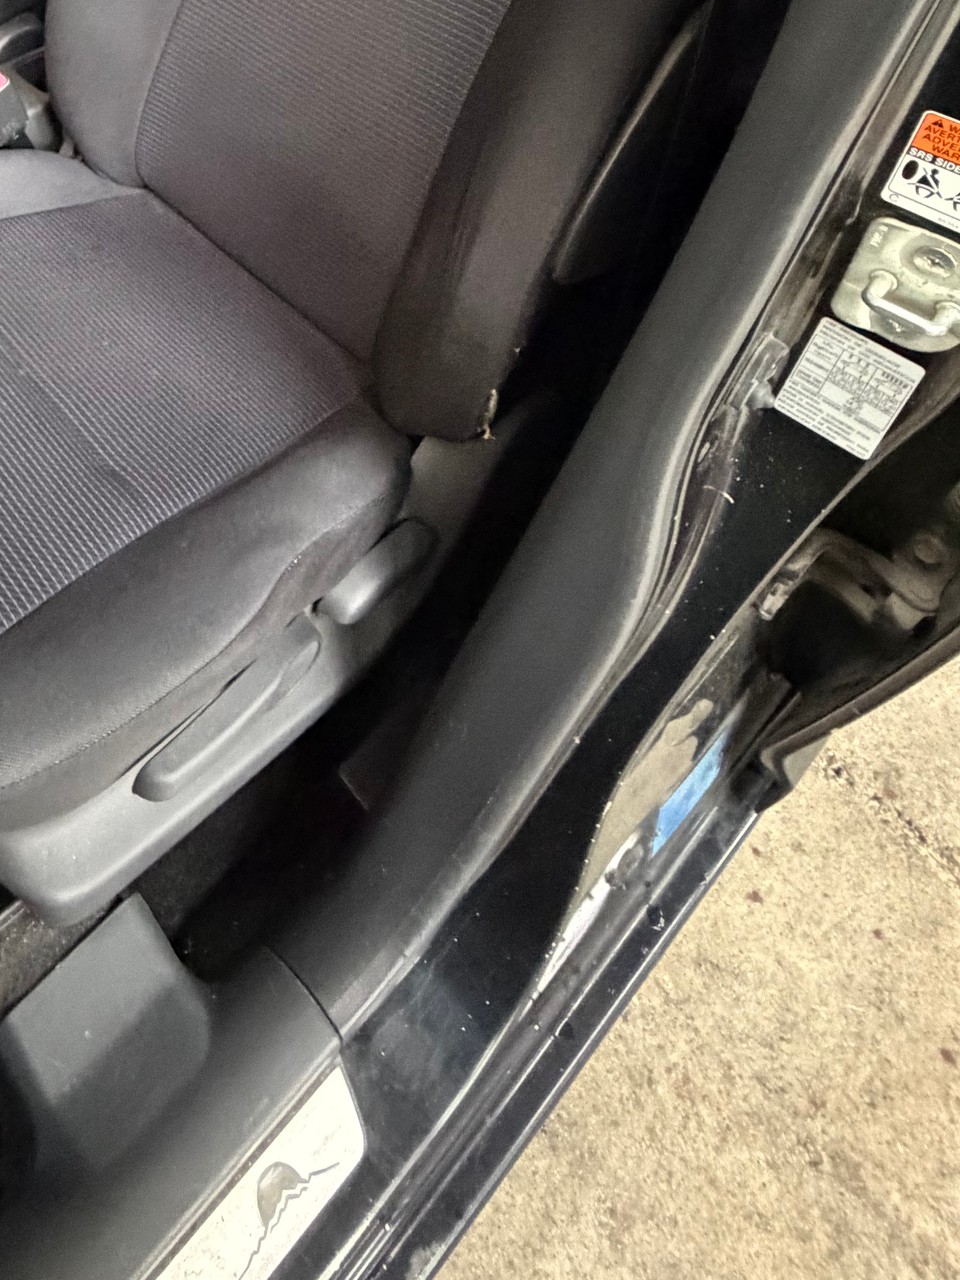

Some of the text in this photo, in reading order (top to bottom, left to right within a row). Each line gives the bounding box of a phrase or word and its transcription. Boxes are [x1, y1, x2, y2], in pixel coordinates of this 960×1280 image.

[922, 133, 960, 152] ADVE
[909, 146, 960, 174] SRS SIDE
